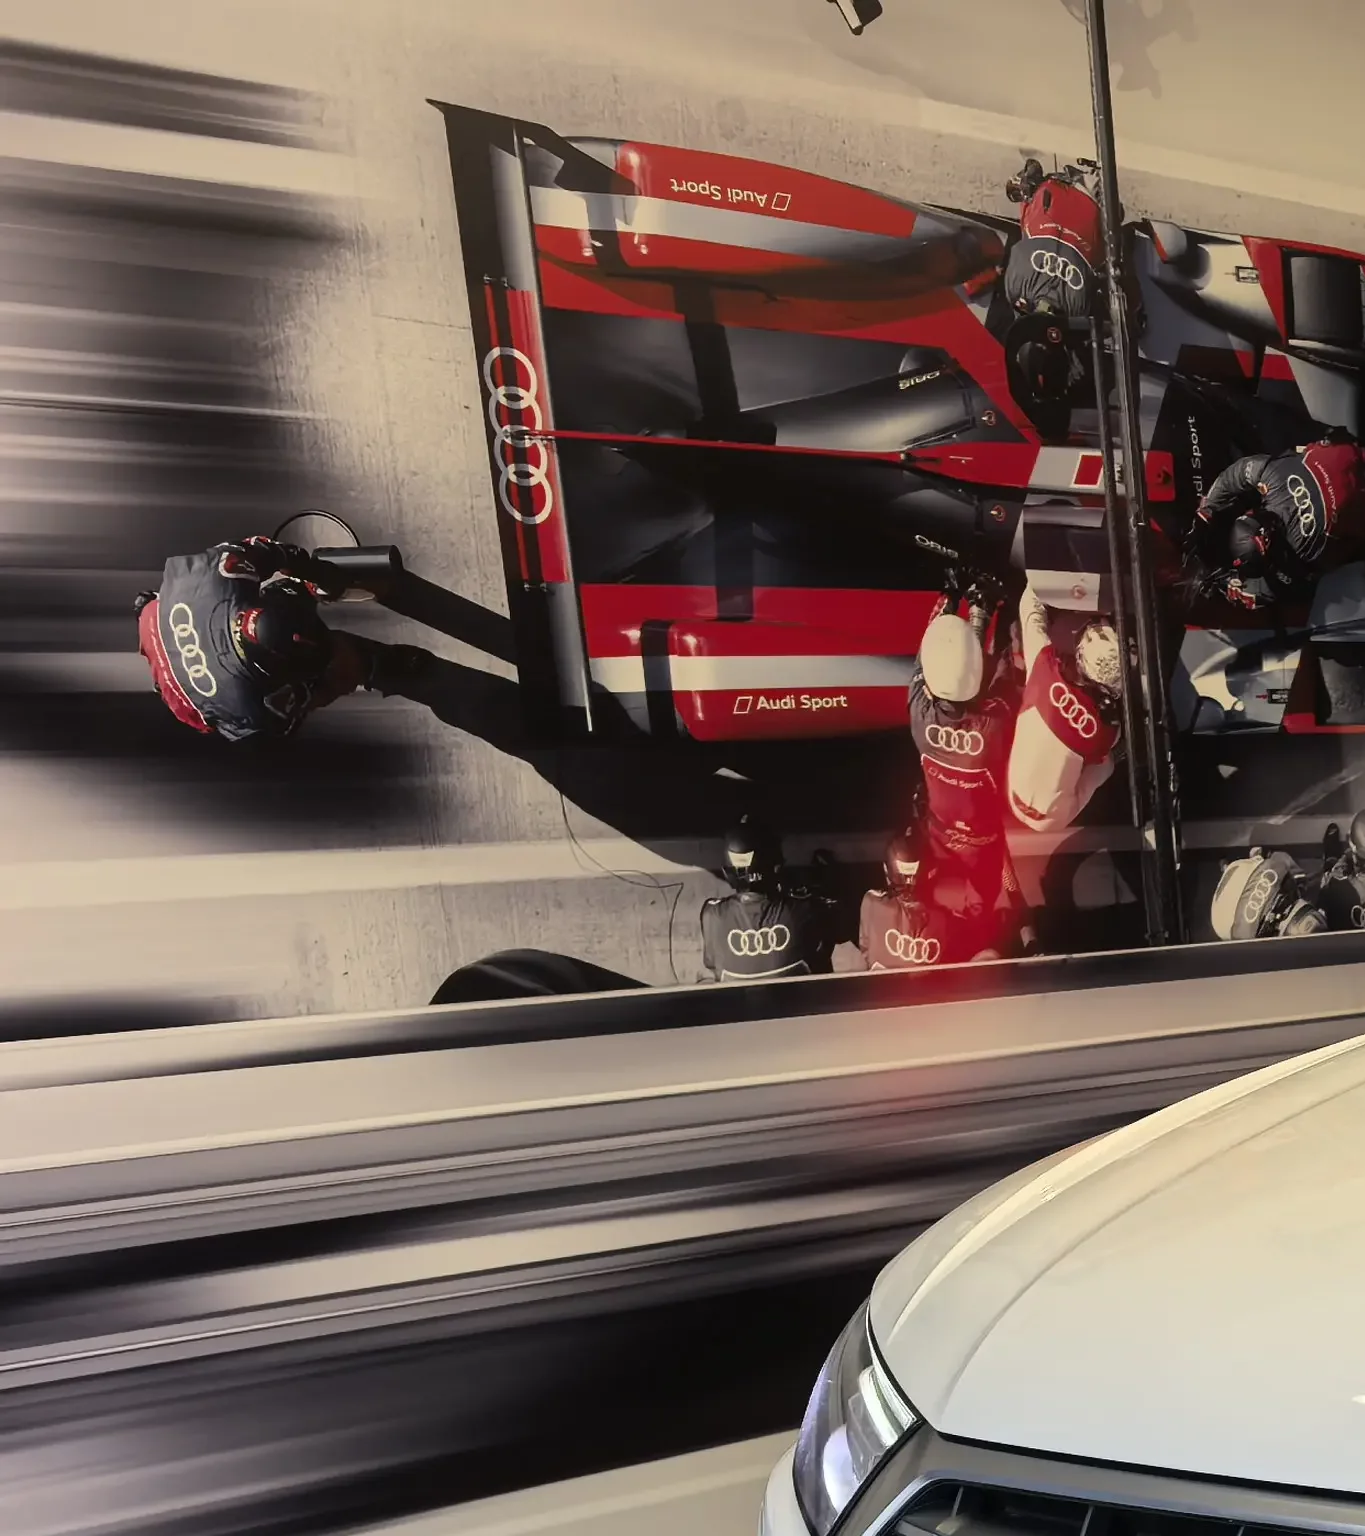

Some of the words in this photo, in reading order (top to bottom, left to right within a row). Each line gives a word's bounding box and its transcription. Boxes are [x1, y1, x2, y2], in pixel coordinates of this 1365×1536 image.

[670, 178, 721, 200] Sport
[727, 187, 768, 207] Audi
[756, 694, 796, 710] Audi
[800, 694, 848, 711] Sport
